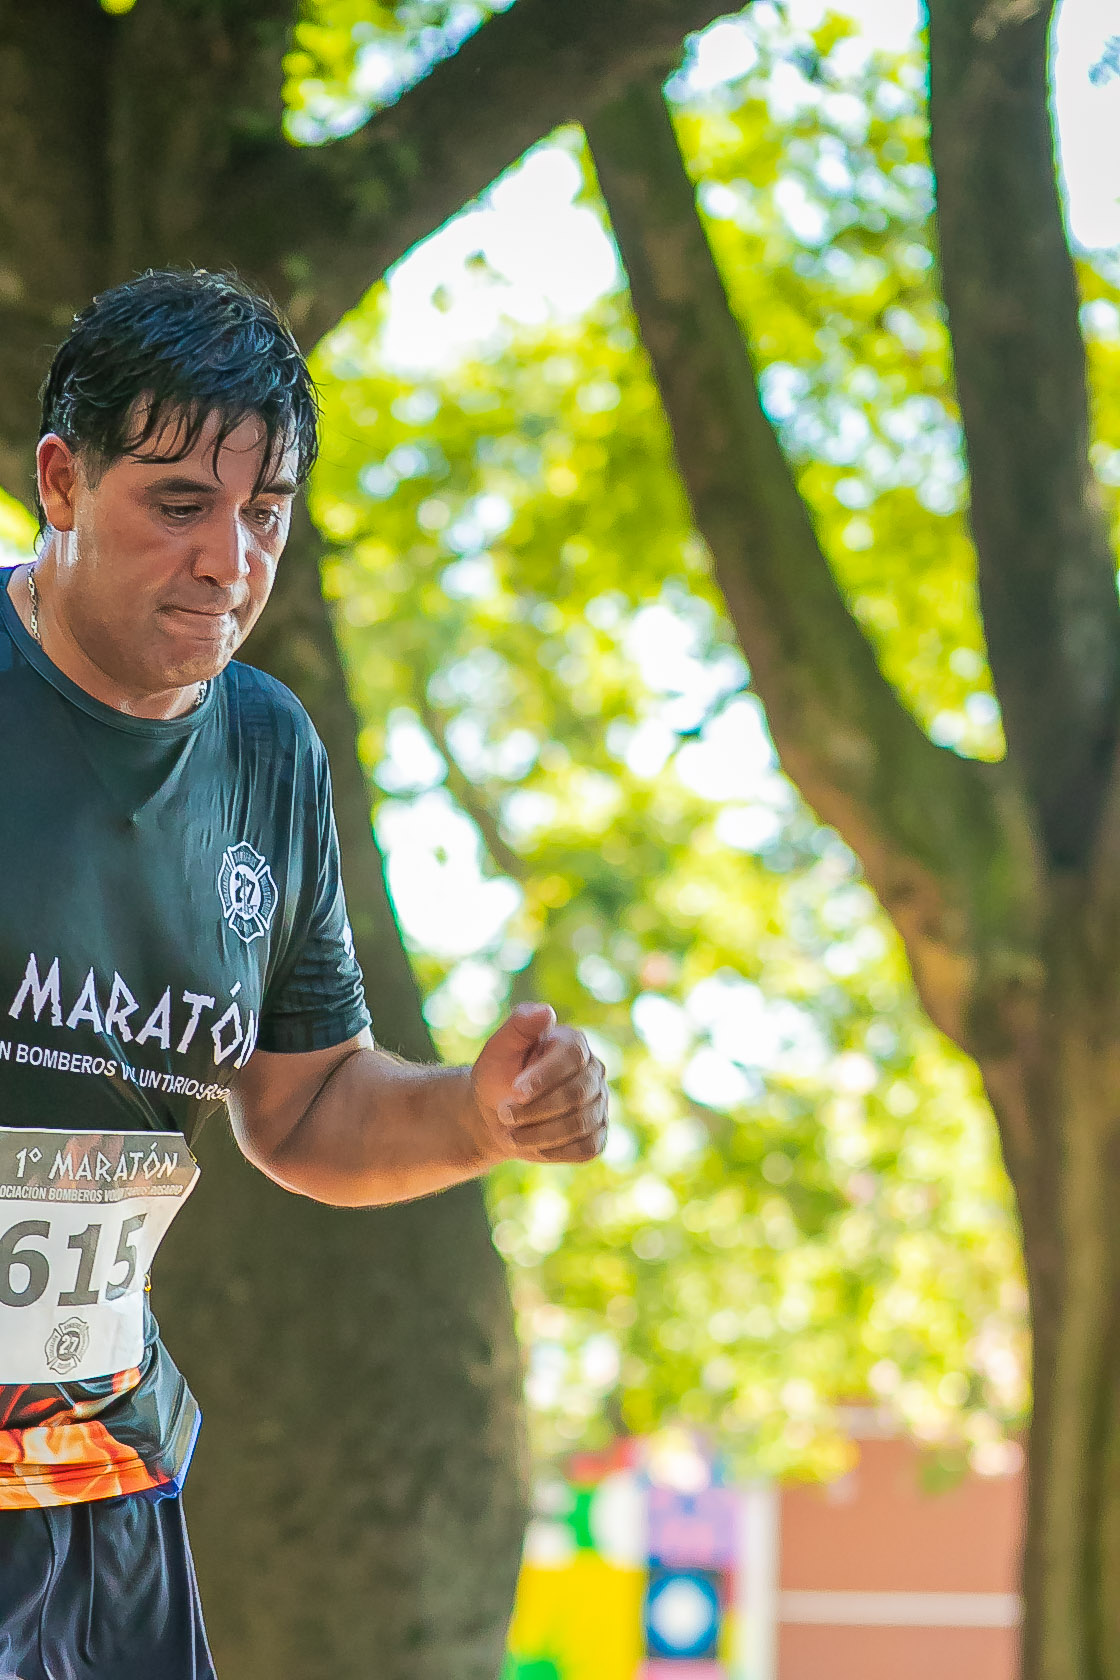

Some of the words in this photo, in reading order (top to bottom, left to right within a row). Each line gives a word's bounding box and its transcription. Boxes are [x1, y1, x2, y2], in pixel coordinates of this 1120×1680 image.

[15, 1043, 117, 1077] BOMBEROS
[48, 1141, 178, 1183] MARATÓN
[48, 1187, 103, 1203] BOMBEROS
[58, 1333, 80, 1355] 27
